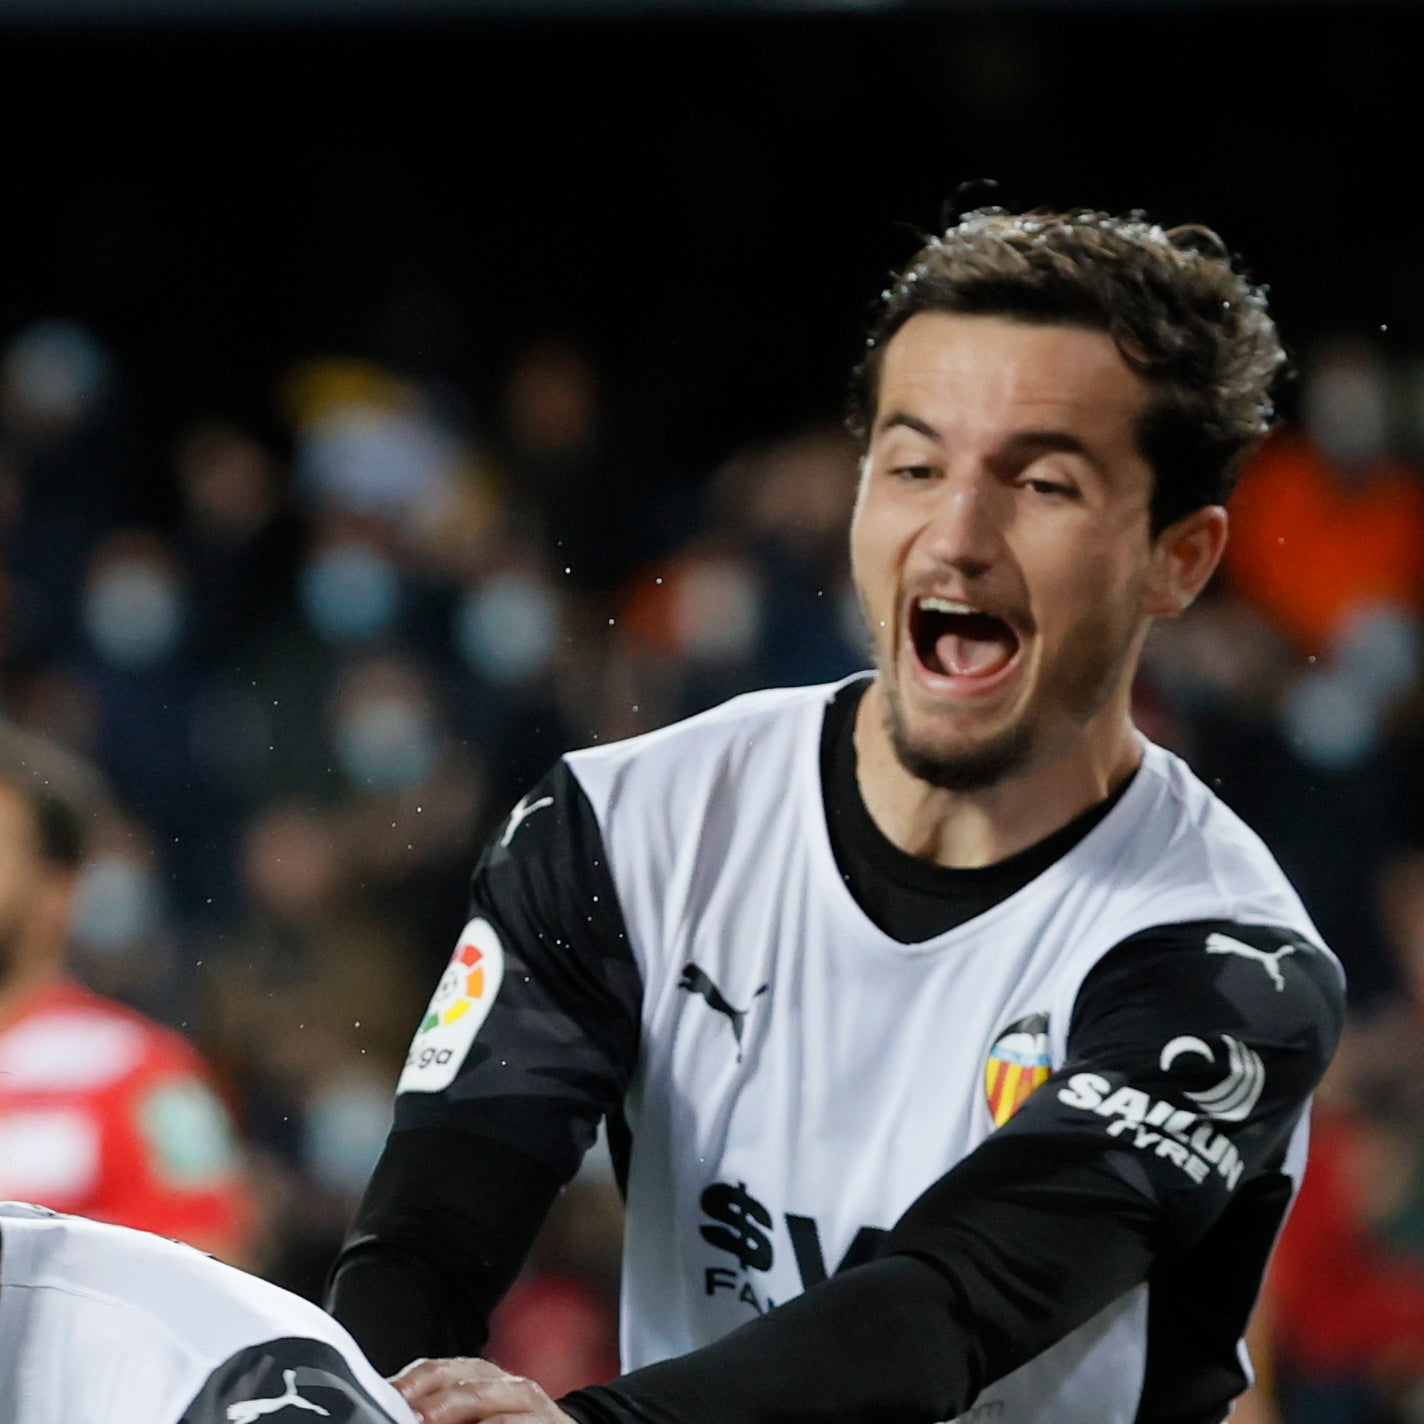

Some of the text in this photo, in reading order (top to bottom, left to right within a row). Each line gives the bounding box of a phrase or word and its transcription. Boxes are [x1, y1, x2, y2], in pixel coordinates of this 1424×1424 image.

[1057, 1073, 1244, 1192] SAILUN
[1106, 1119, 1211, 1185] TYRE
[706, 1267, 775, 1315] FA
